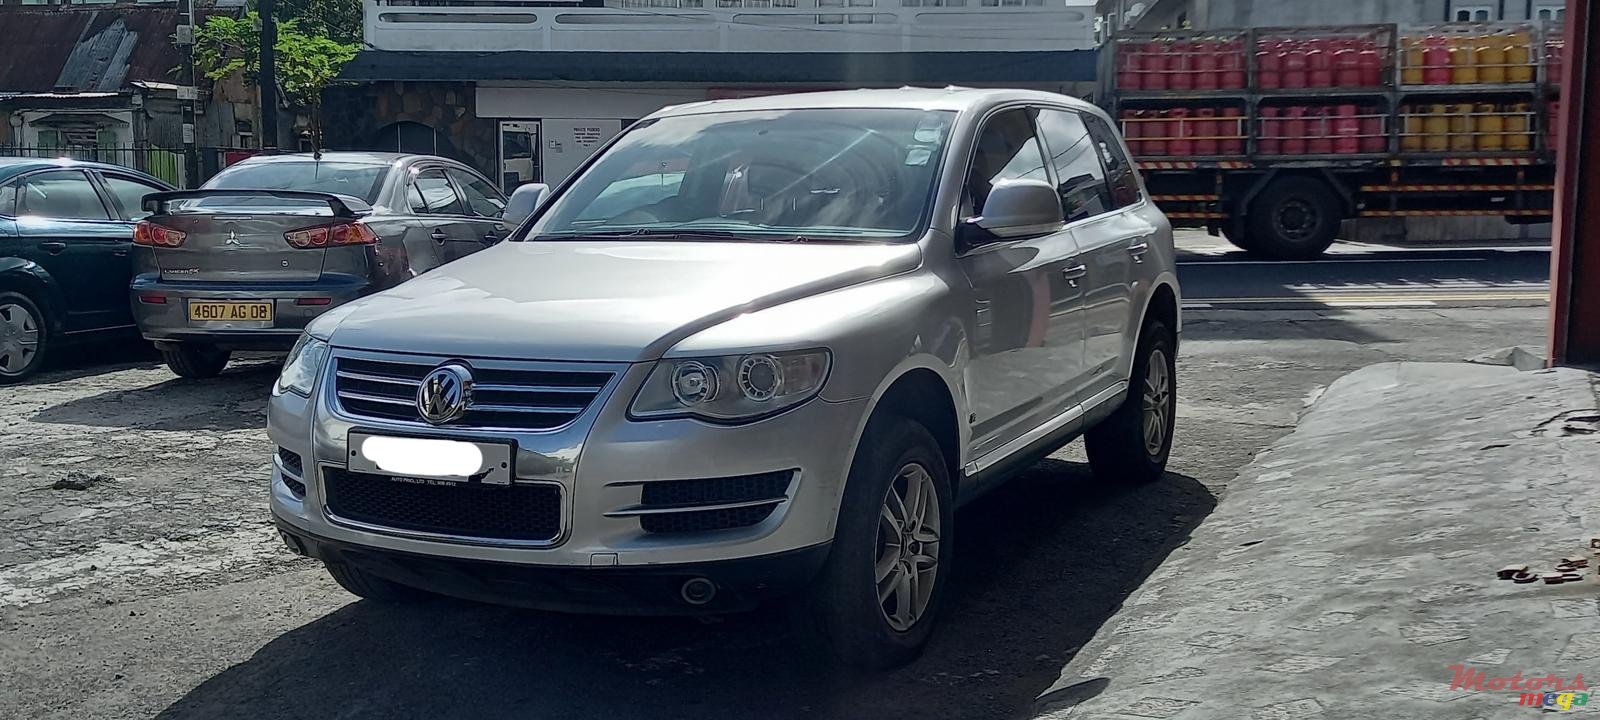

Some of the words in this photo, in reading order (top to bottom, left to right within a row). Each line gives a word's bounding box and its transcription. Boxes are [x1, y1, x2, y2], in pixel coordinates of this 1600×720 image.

[194, 305, 225, 319] 4607
[231, 305, 246, 319] AG
[251, 305, 267, 319] 08
